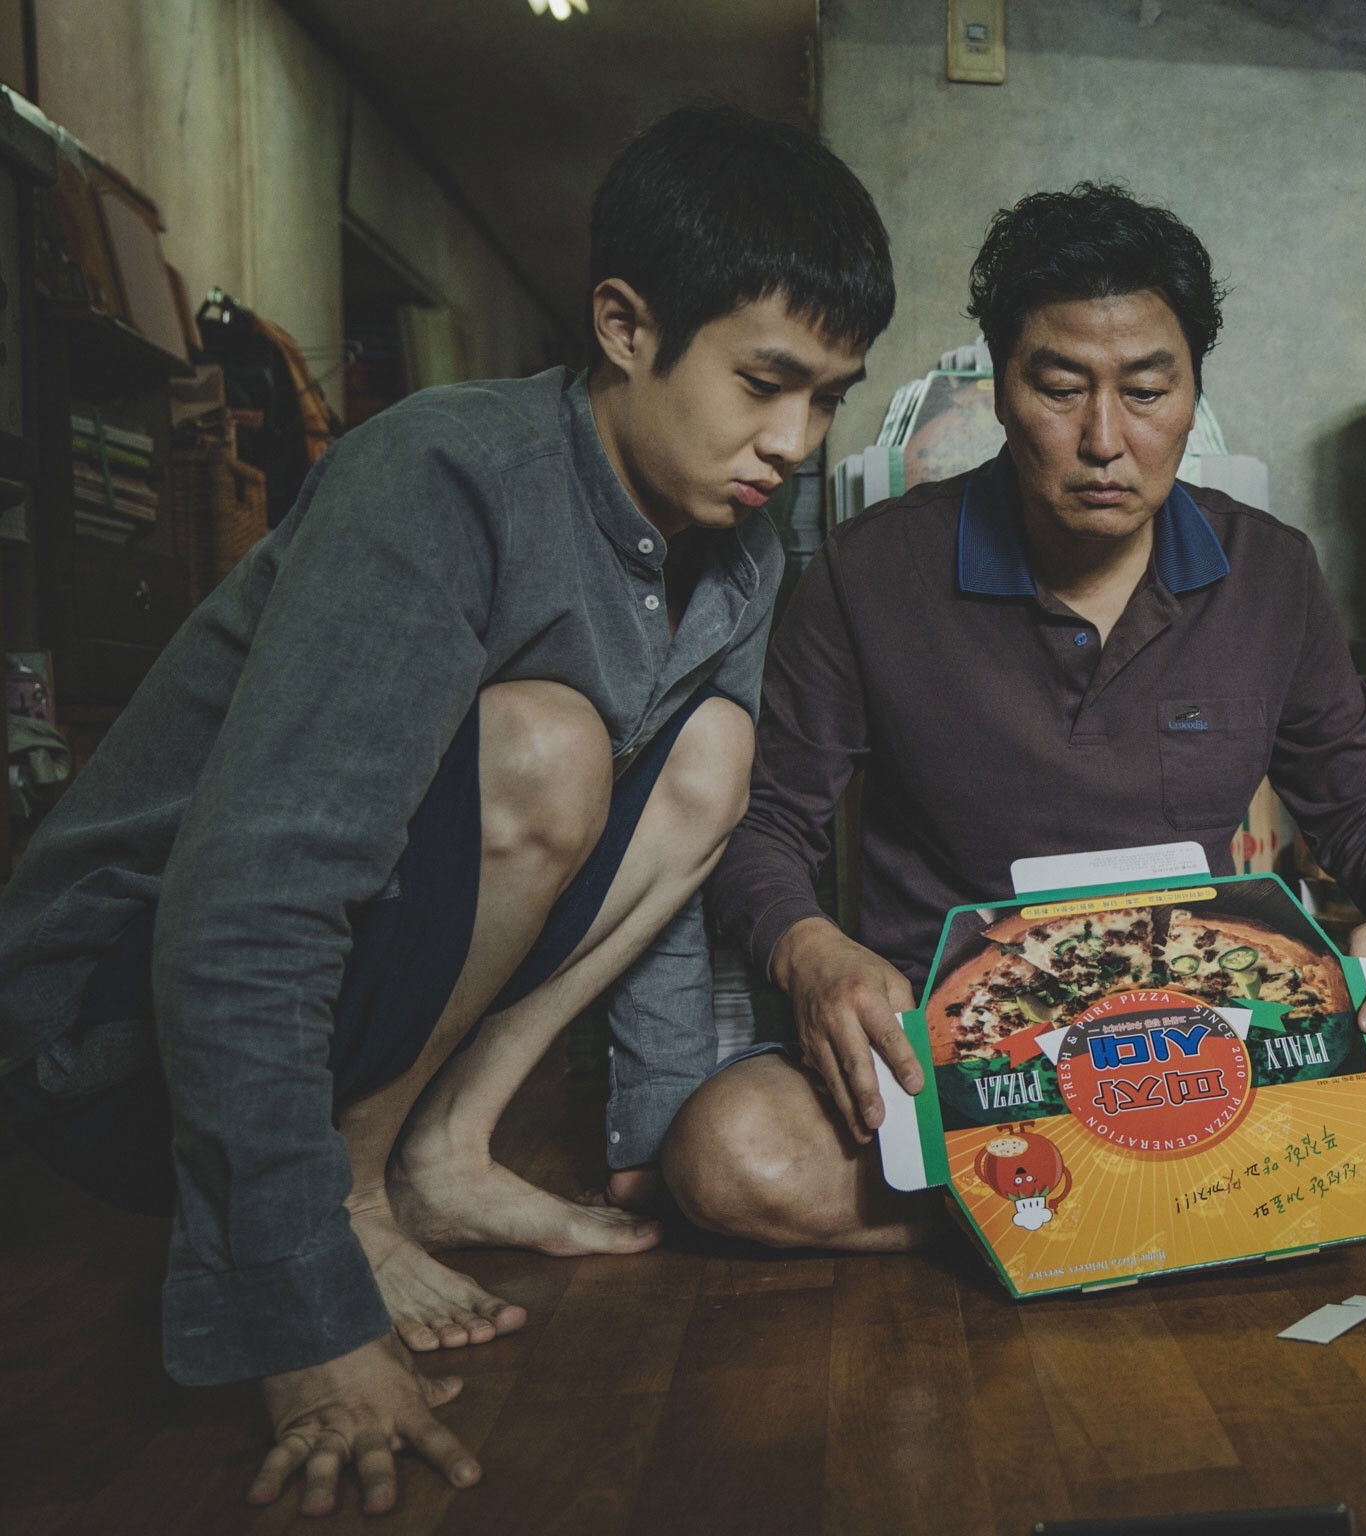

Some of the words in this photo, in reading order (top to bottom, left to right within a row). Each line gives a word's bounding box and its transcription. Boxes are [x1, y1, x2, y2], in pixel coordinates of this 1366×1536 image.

[1075, 1001, 1113, 1030] PURE
[1119, 992, 1170, 1004] PIZZA
[1066, 1035, 1078, 1044] &
[1193, 1004, 1235, 1040] SINCE
[1087, 1024, 1211, 1071] 시대
[1231, 1046, 1246, 1078] 2010
[1264, 1032, 1330, 1070] ITALY
[973, 1070, 1044, 1110] PIZZA
[1060, 1051, 1078, 1100] FRESH
[1093, 1069, 1229, 1116] 피자
[1085, 1116, 1199, 1150] GENERATION
[1205, 1096, 1241, 1134] PIZZA
[1284, 1125, 1338, 1168] 푸짐한
[1309, 1163, 1357, 1199] 신선한
[1253, 1186, 1305, 1218] 재료와
[1068, 1259, 1108, 1273] Delivery
